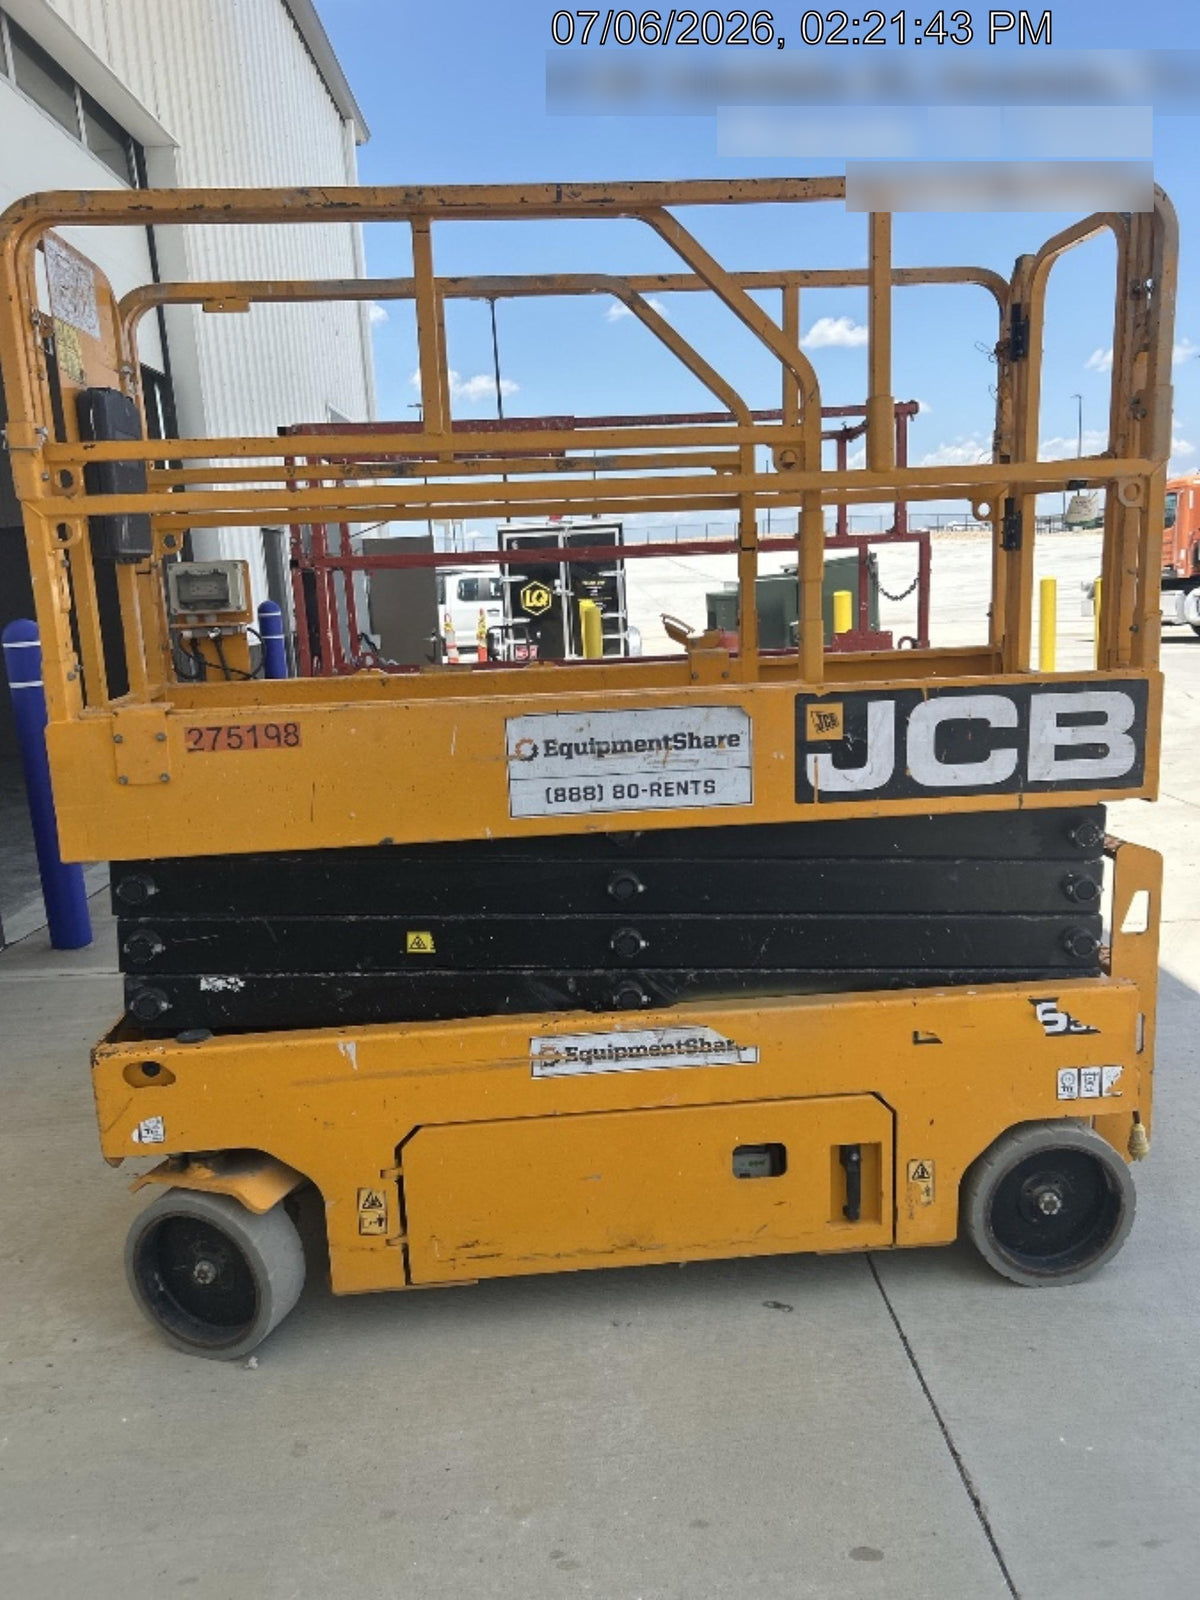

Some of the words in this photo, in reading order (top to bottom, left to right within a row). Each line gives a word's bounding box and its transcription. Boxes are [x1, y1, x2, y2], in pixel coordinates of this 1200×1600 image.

[187, 723, 300, 753] 275198
[543, 732, 741, 760] EquipmentShare
[806, 691, 1136, 791] JCB
[612, 779, 716, 800] 80-RENTS
[564, 1038, 747, 1065] EquipmentShar
